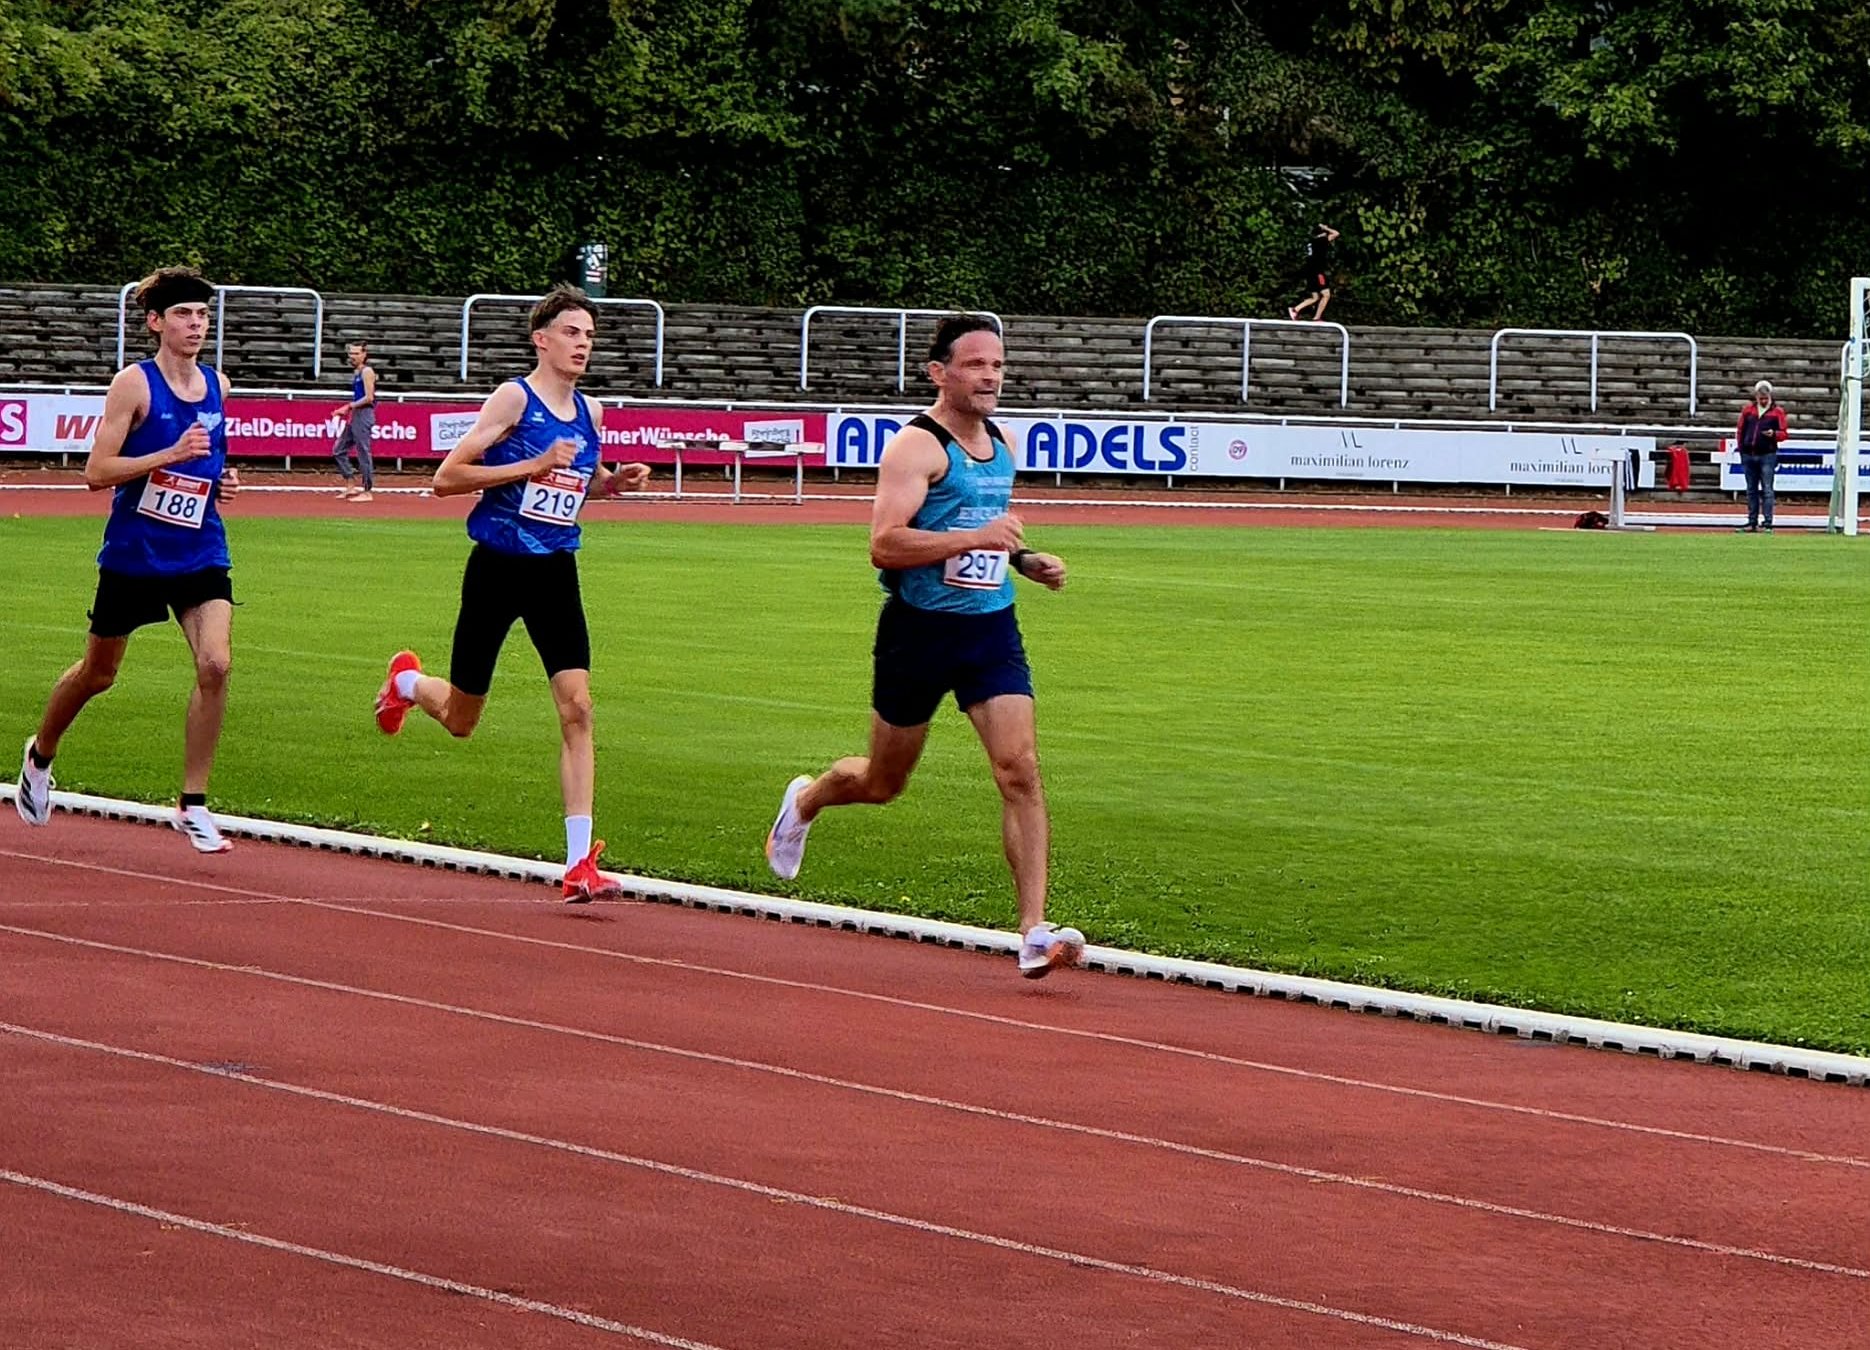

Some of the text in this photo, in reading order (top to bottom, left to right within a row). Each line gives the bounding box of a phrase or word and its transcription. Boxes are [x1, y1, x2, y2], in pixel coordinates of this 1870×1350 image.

[1026, 422, 1187, 471] ADELS
[1291, 454, 1409, 469] maximilian lorenz
[1510, 459, 1584, 474] maximilian
[155, 490, 197, 518] 188
[532, 488, 576, 517] 219
[957, 552, 1000, 580] 297
